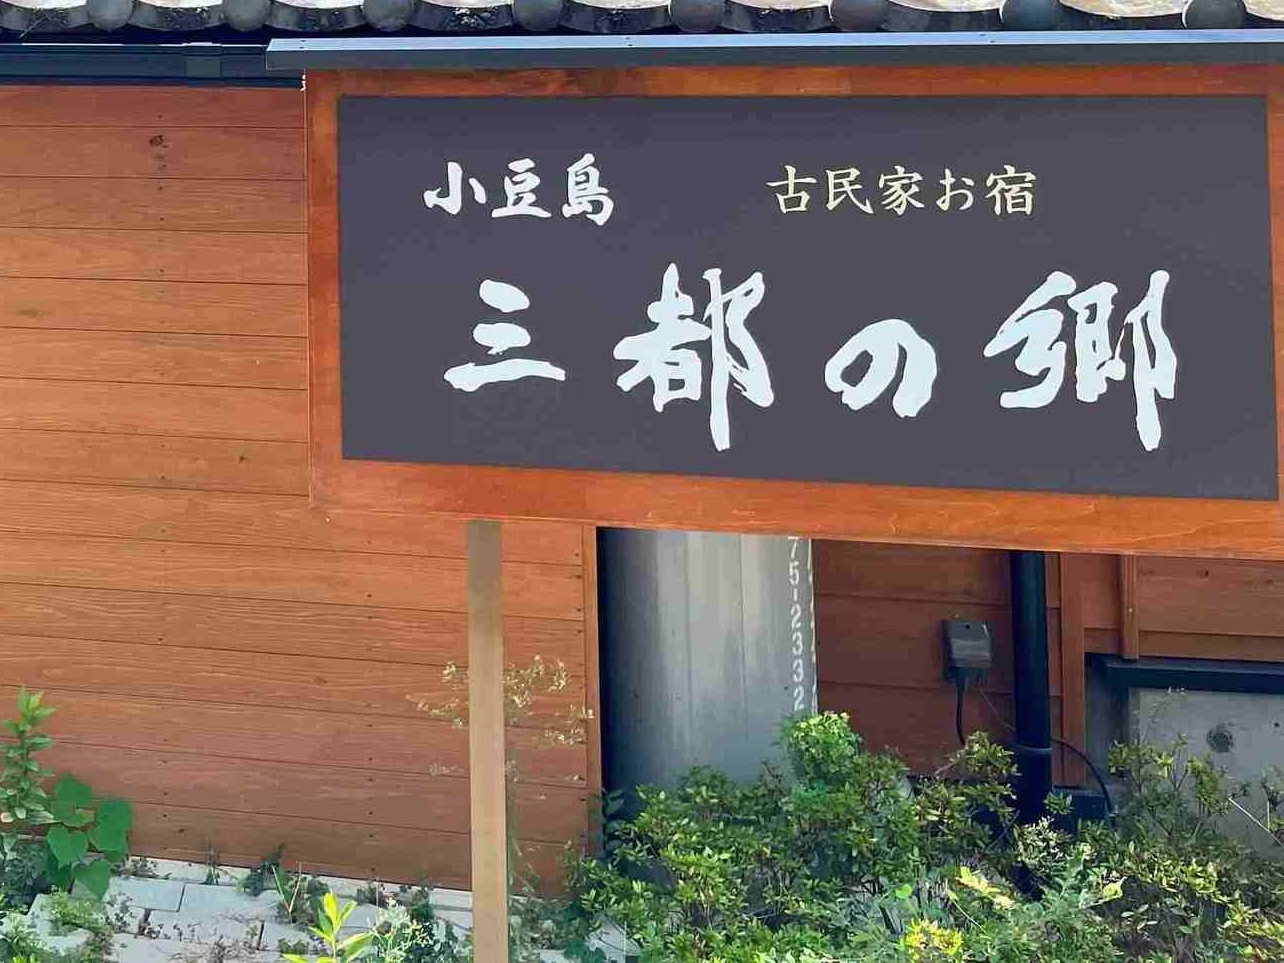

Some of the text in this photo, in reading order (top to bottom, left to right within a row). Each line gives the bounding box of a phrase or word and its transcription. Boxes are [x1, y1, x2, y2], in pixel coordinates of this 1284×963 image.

[423, 152, 616, 226] 小豆島
[765, 163, 1038, 217] 古民家お宿
[443, 262, 1179, 452] 三都の郷
